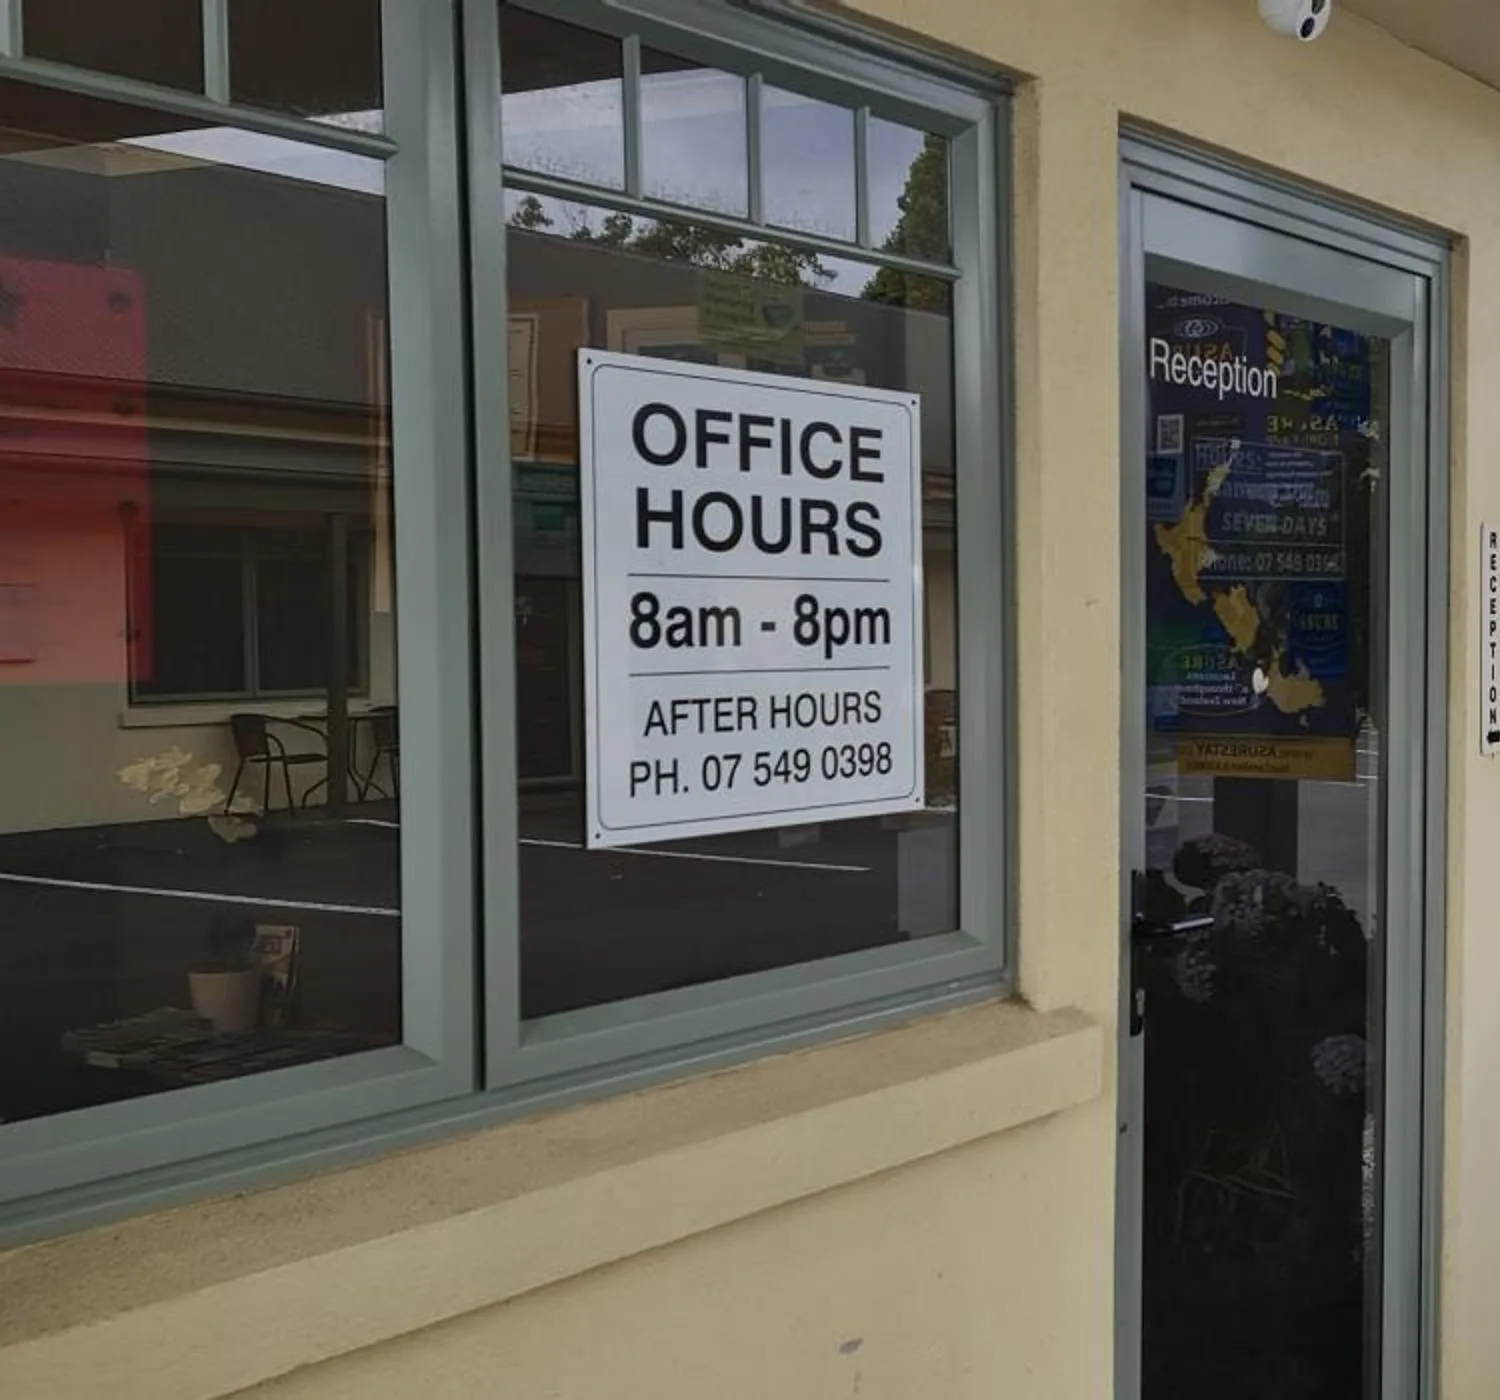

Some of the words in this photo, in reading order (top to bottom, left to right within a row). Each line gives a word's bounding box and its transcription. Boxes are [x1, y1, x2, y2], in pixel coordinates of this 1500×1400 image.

[1150, 337, 1277, 400] Reception
[632, 402, 885, 483] OFFICE
[635, 487, 883, 558] HOURS
[1282, 516, 1329, 536] DAYS
[629, 591, 741, 649] 8am
[793, 594, 891, 660] 8pm
[1488, 531, 1498, 724] RECEPTION
[643, 697, 758, 738] AFTER
[771, 690, 882, 730] HOURS
[630, 759, 688, 798] PH.
[702, 754, 742, 792] 07
[754, 746, 811, 786] 549
[821, 742, 893, 780] 0398
